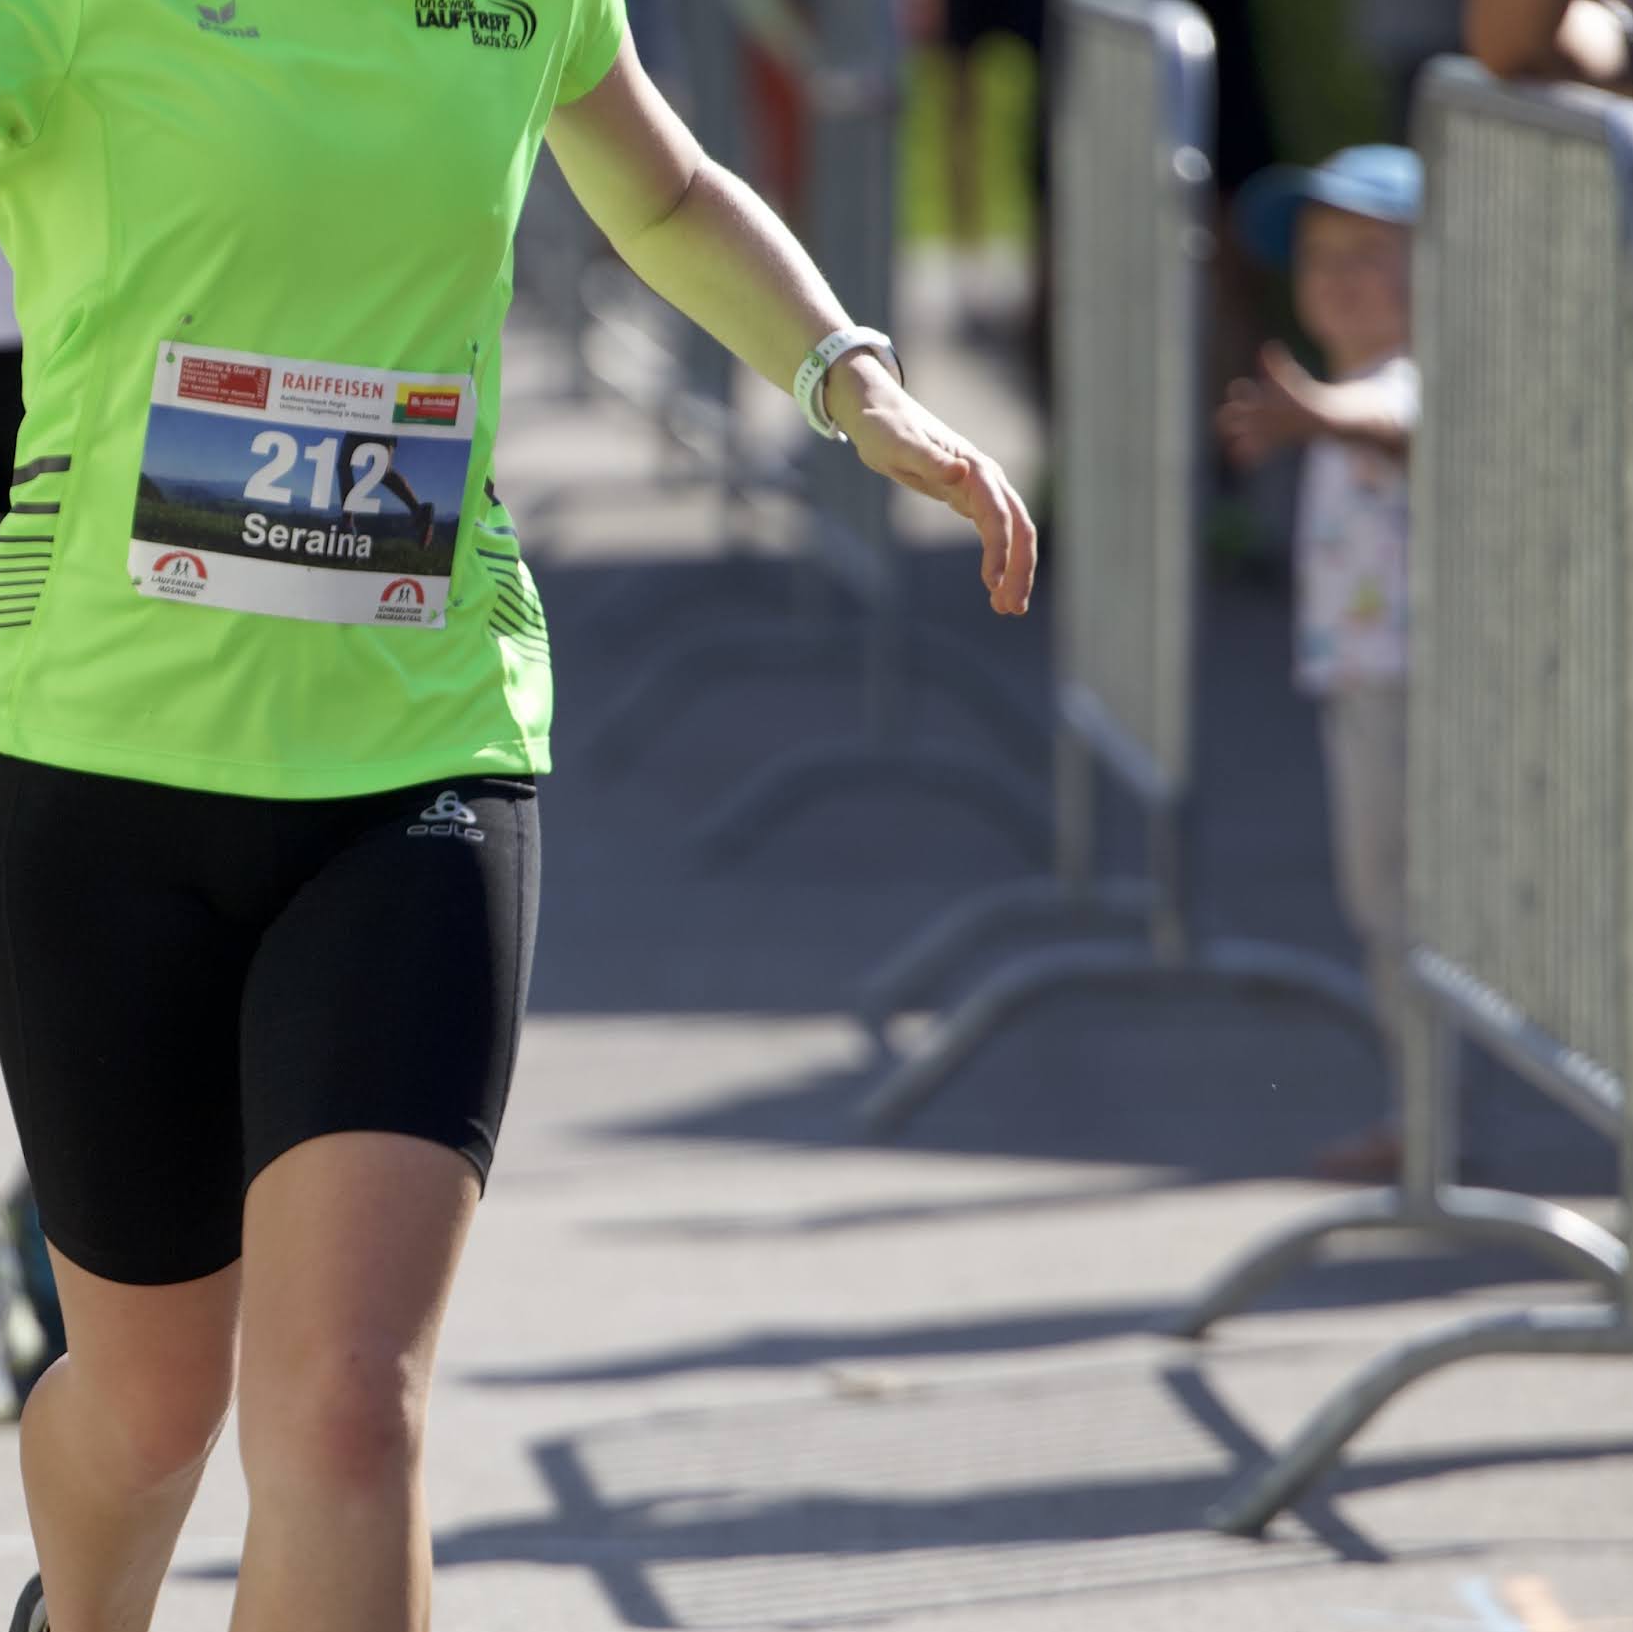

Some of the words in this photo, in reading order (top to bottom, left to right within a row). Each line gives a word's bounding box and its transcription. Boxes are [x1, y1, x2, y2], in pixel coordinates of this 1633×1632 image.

[415, 9, 510, 33] LAUF-TREFF
[282, 371, 384, 400] RAIFFEISEN
[243, 430, 389, 514] 212
[242, 512, 372, 559] Seraina
[406, 823, 485, 842] odlo
